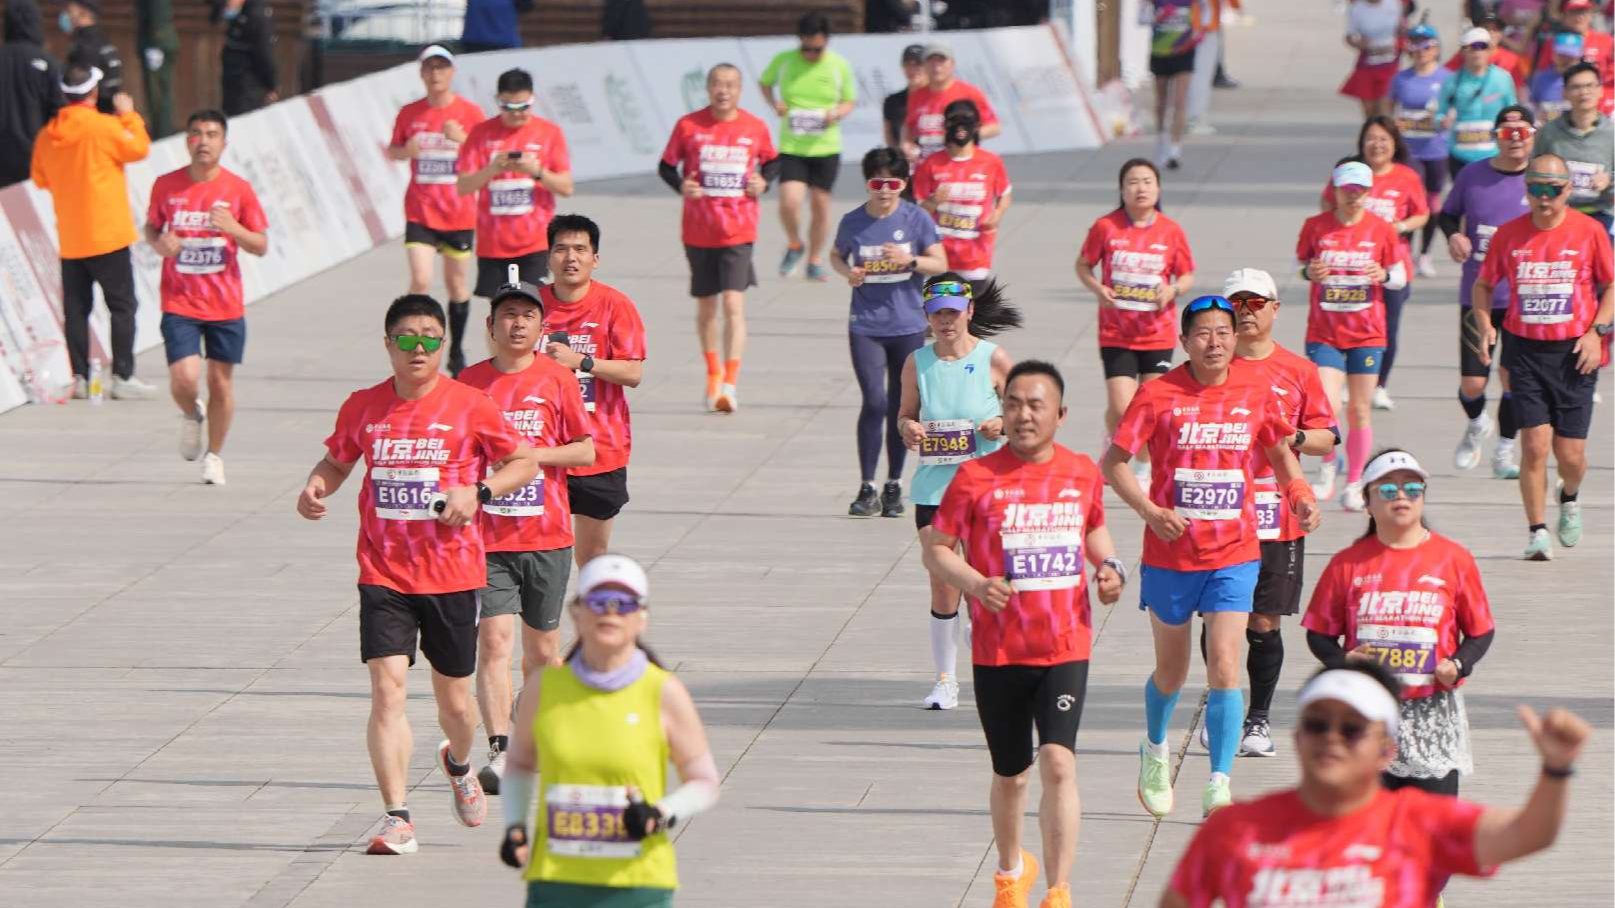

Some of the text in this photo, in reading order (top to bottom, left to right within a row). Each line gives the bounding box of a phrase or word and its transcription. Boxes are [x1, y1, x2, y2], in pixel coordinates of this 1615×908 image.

[1523, 298, 1567, 312] E2077
[514, 410, 540, 420] BEI
[1178, 422, 1247, 444] 北京 BEI
[1219, 434, 1251, 444] JING
[372, 438, 445, 460] 北京 BEI
[922, 436, 969, 452] E7948
[412, 450, 451, 460] JING
[379, 487, 432, 504] E1616
[1181, 488, 1238, 505] E2970
[1002, 503, 1052, 527] 北京
[1013, 553, 1076, 574] E1742
[1358, 591, 1407, 615] 北京
[1405, 604, 1444, 617] JING
